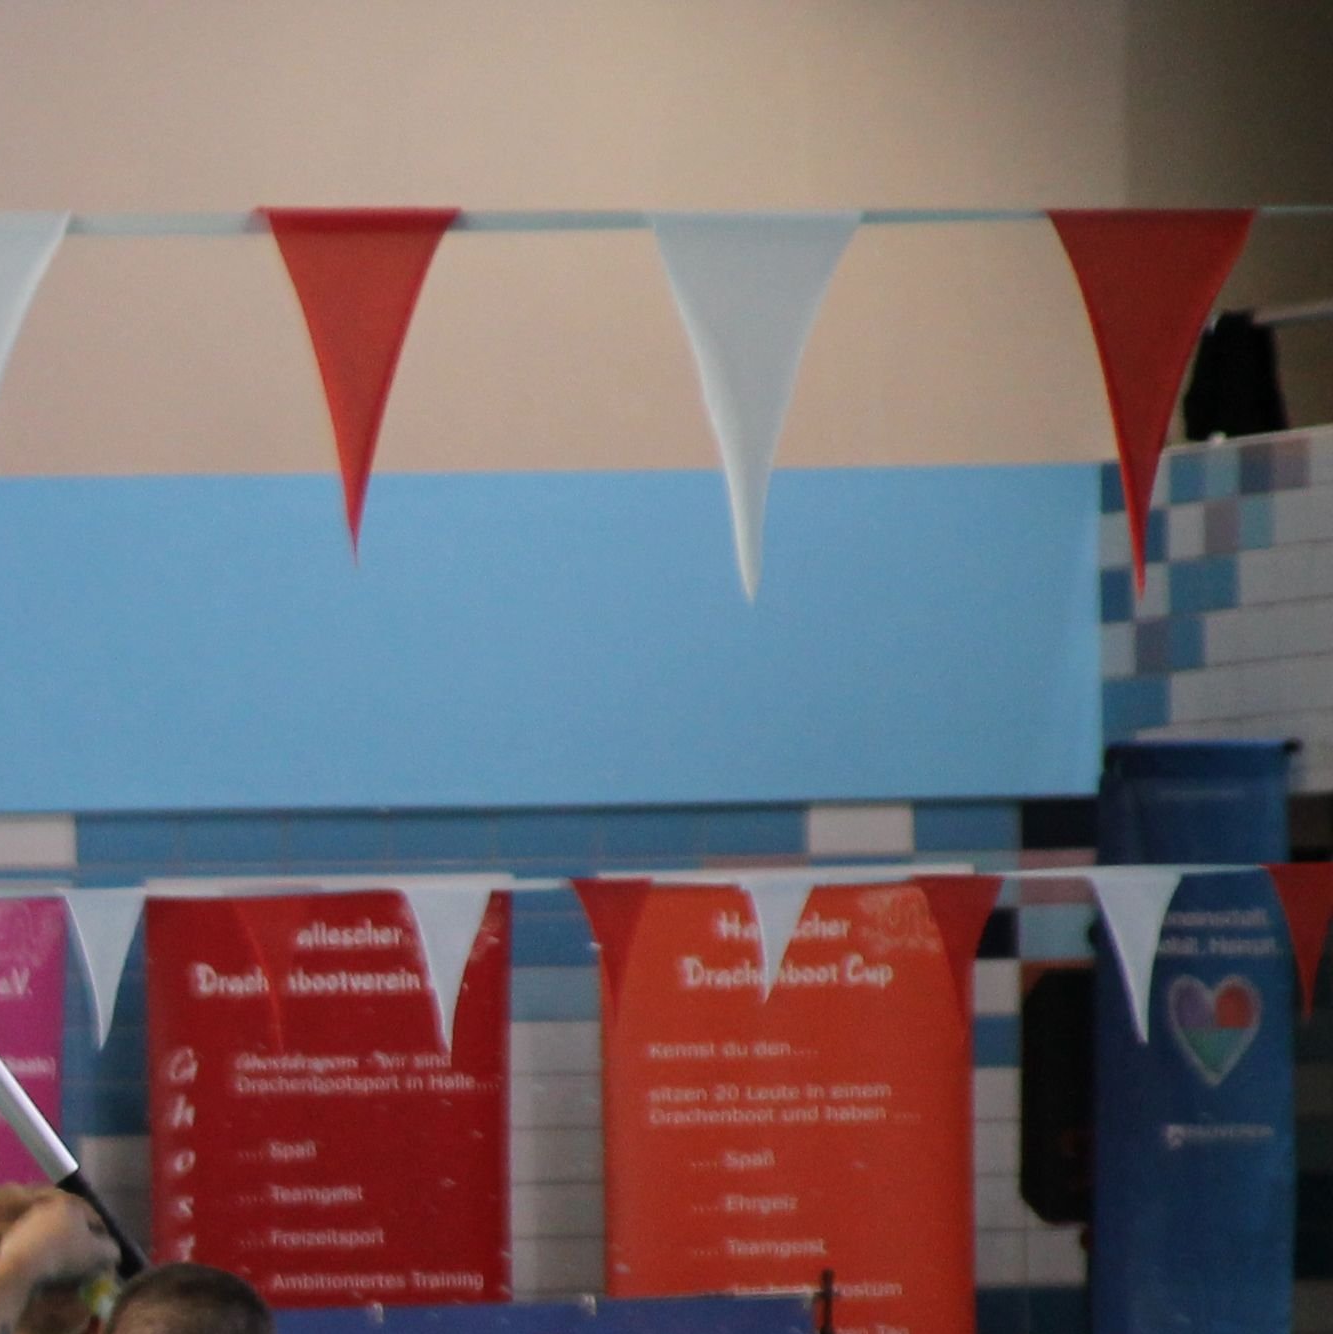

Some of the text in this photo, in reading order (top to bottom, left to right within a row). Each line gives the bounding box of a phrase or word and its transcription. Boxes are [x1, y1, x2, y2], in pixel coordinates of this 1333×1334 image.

[295, 918, 404, 949] allescher
[846, 953, 894, 988] Cup
[407, 1074, 423, 1090] in
[746, 1084, 800, 1101] Leute
[650, 1106, 774, 1125] Drachenboot
[781, 1105, 819, 1122] und
[826, 1104, 887, 1121] haben
[271, 1272, 484, 1291] Ambitioniertes Training
